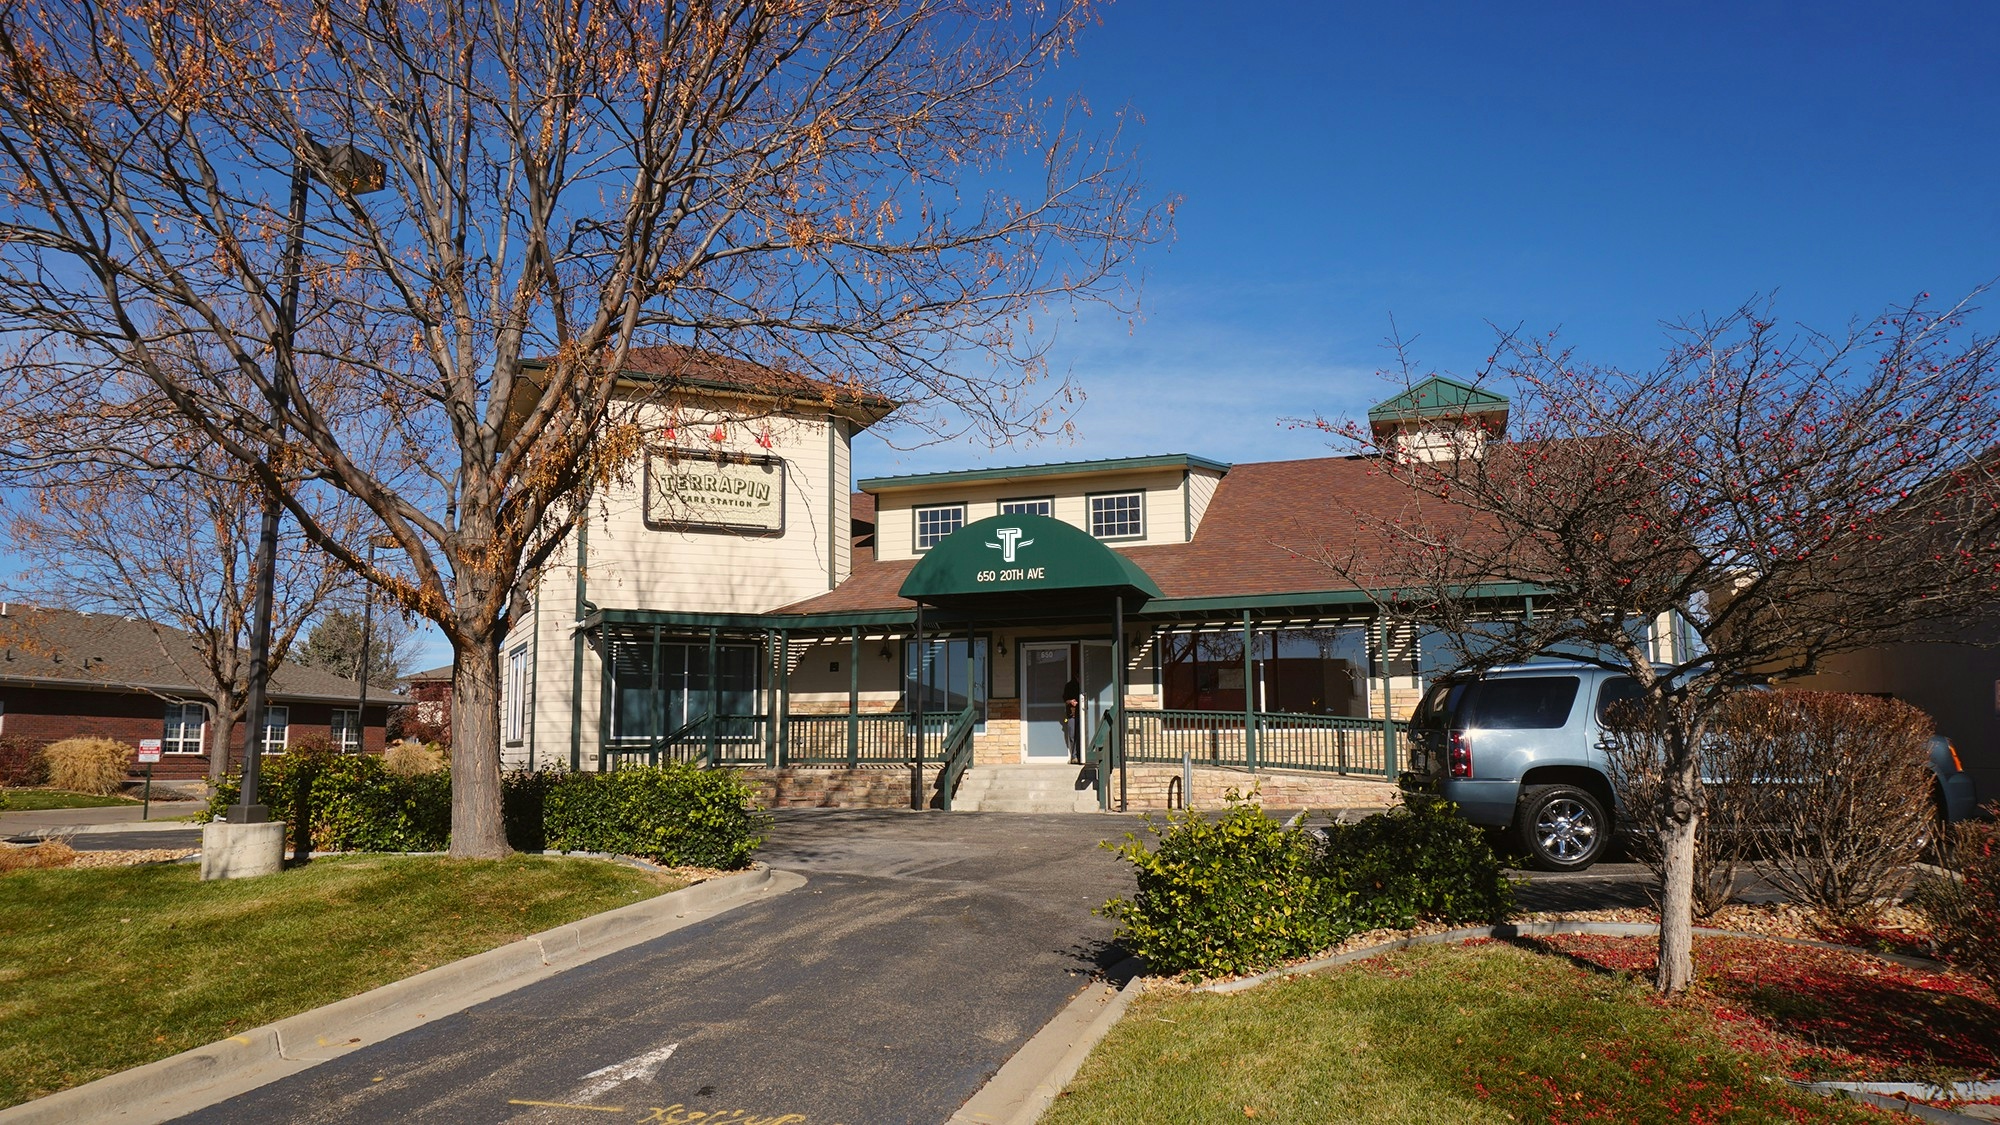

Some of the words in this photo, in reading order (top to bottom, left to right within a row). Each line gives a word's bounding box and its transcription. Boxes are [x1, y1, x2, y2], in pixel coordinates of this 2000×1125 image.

[661, 474, 770, 501] TERRAPIN
[710, 498, 752, 508] STATION
[977, 570, 996, 582] 650
[1000, 568, 1024, 581] 20TH
[1027, 567, 1045, 580] AVE
